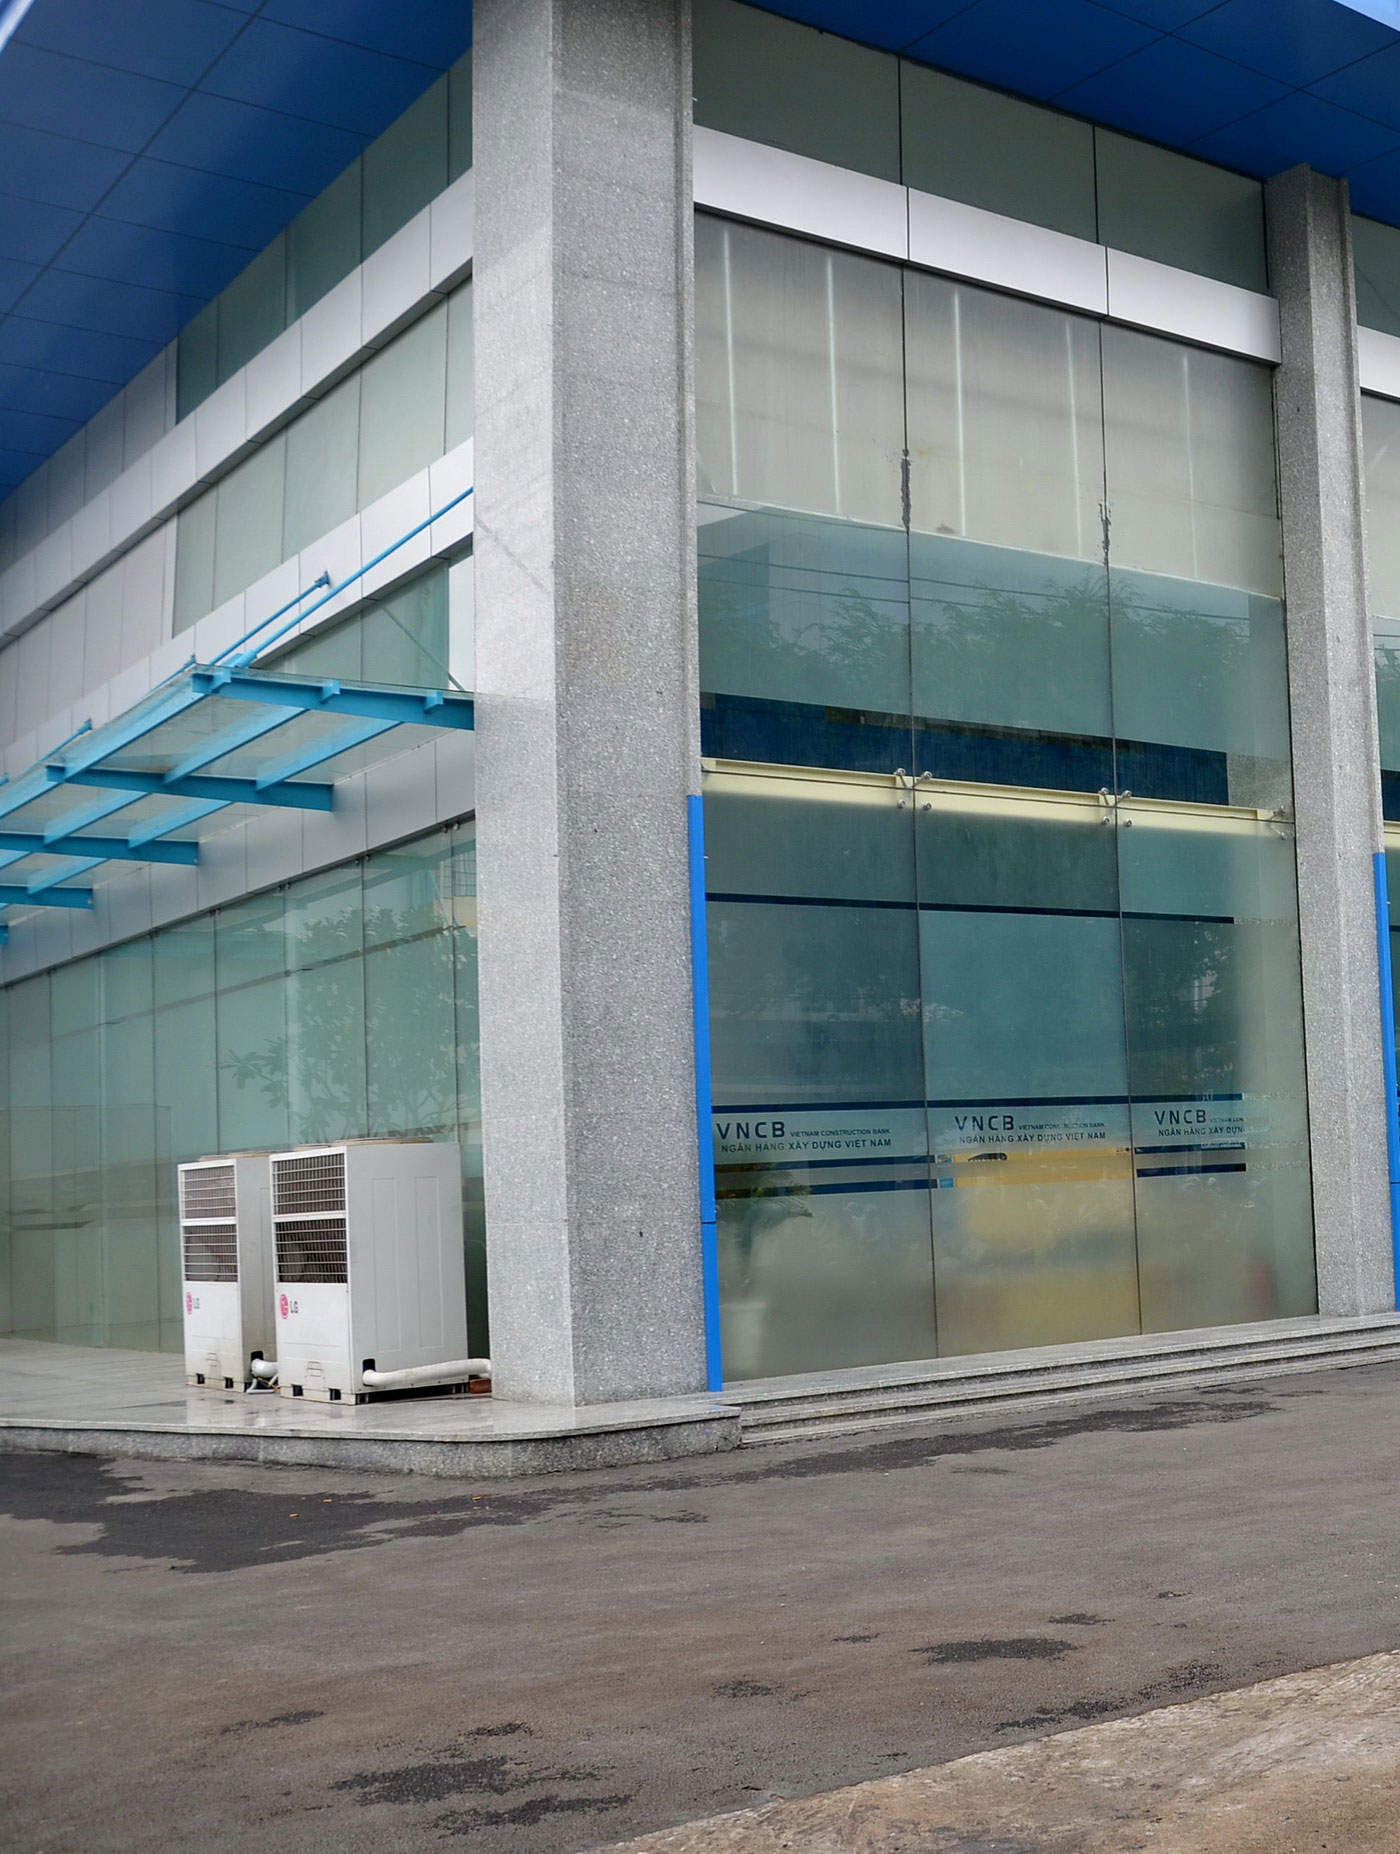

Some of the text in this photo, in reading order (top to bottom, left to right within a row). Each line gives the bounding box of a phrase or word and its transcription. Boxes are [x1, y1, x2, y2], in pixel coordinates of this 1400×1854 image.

[954, 1114, 1015, 1131] VNCB
[1154, 1109, 1207, 1125] VNCB
[716, 1121, 785, 1140] VNCB
[790, 1130, 820, 1138] VIETNAM
[820, 1129, 872, 1137] CONSTRUCTION
[1087, 1131, 1106, 1140] NAM
[870, 1138, 892, 1147] NAM
